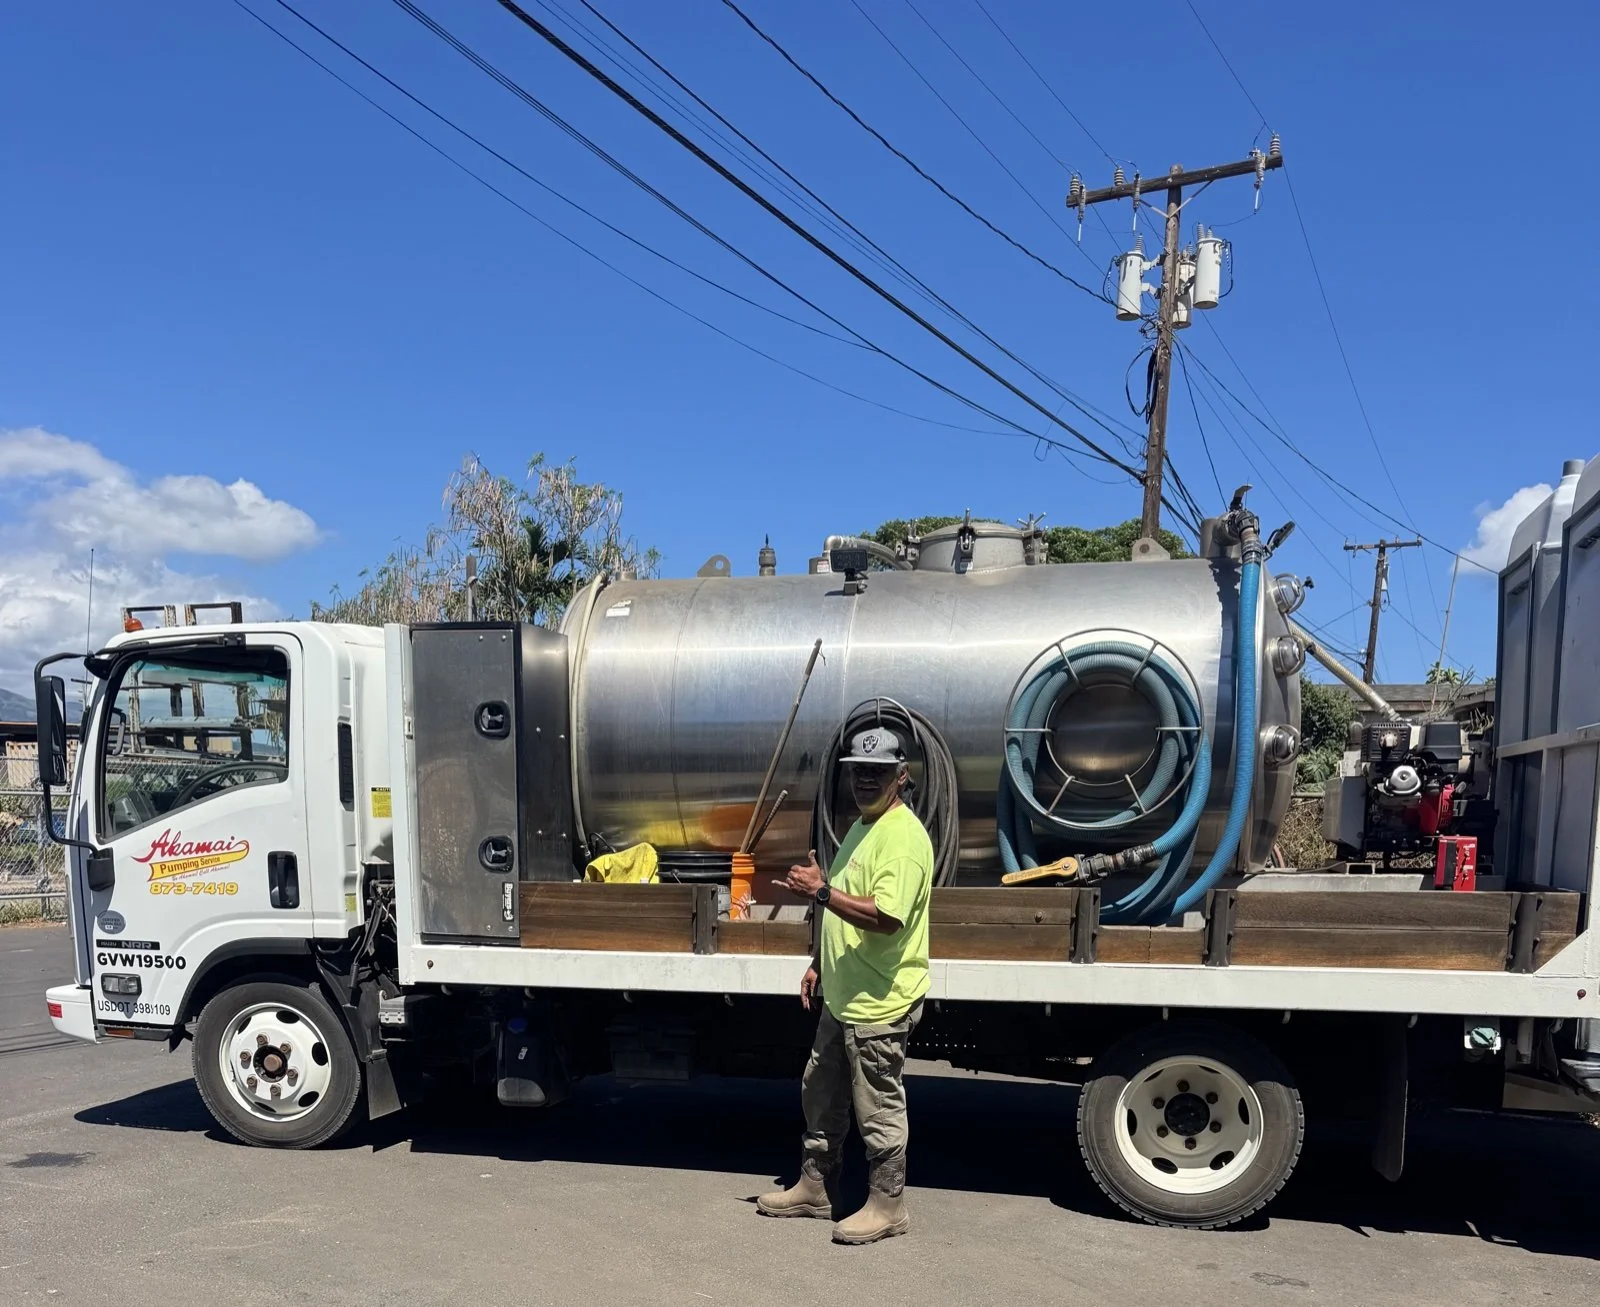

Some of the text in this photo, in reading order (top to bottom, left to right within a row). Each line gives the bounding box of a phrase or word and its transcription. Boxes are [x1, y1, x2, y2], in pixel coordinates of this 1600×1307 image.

[131, 828, 236, 863] Akamai
[160, 856, 221, 874] Pumping Service
[150, 882, 239, 896] 873-7419
[121, 941, 152, 949] NRR
[97, 952, 187, 970] GVW19500
[97, 1000, 130, 1013] USDOT
